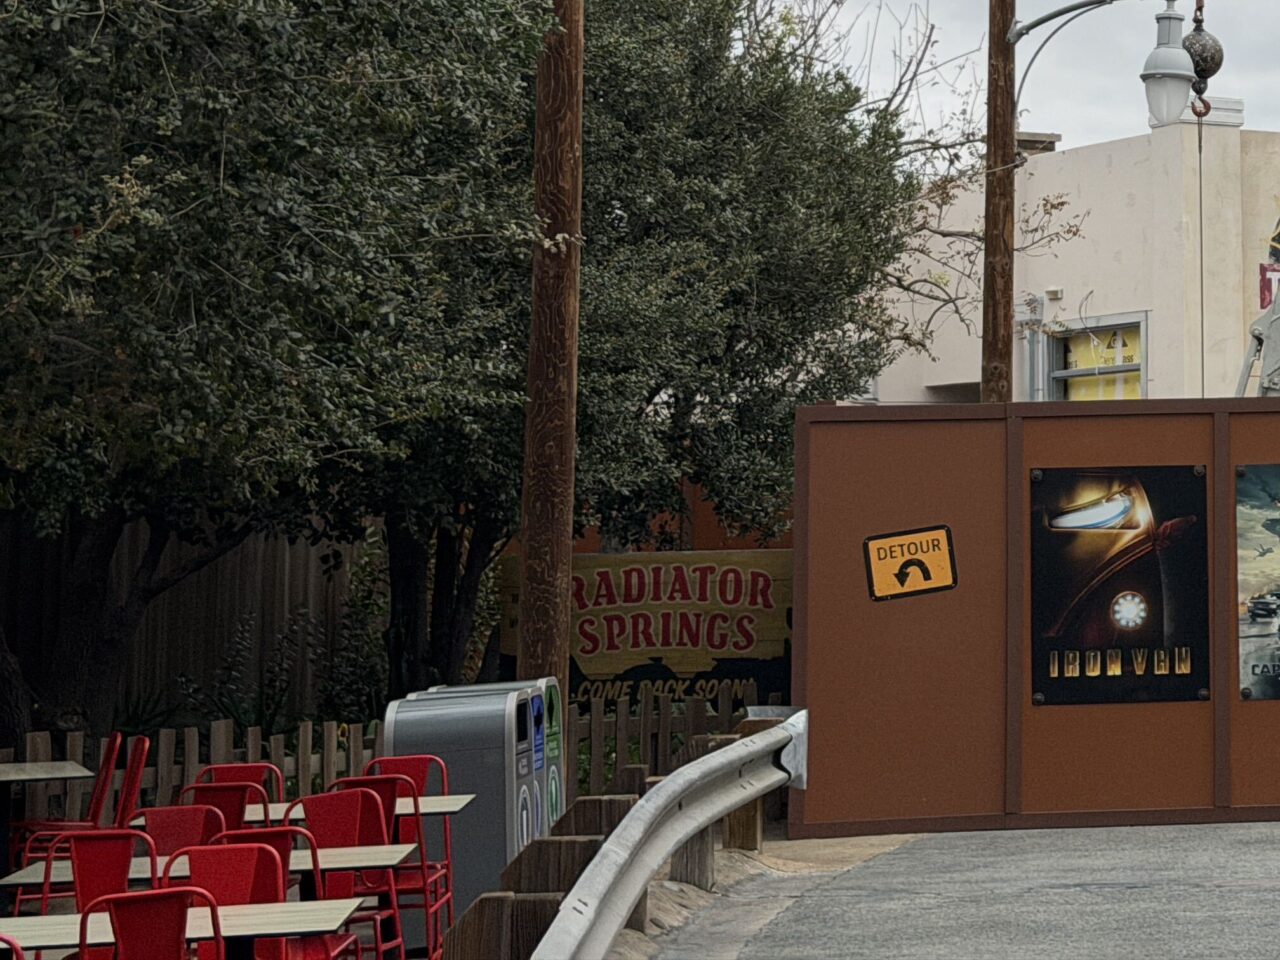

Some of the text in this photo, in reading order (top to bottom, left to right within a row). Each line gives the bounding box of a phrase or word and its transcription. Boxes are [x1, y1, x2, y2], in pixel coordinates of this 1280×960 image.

[877, 538, 942, 561] DETOUR
[571, 564, 775, 610] RADIATOR
[578, 611, 755, 654] SPRINGS
[1049, 647, 1191, 678] IRON VAN
[578, 680, 633, 700] COME
